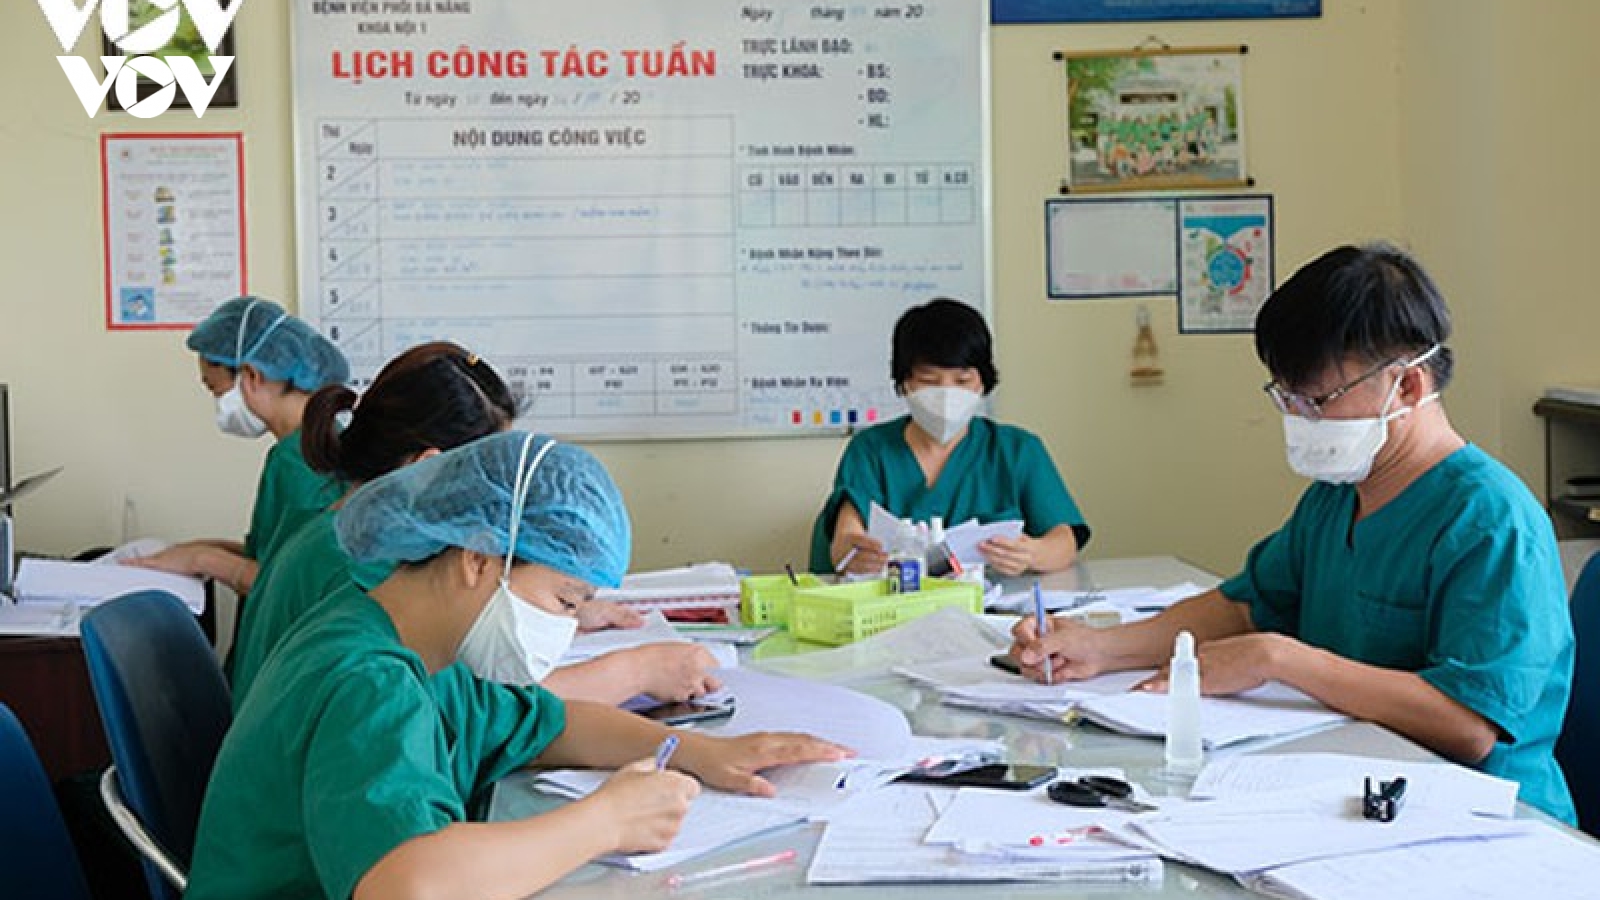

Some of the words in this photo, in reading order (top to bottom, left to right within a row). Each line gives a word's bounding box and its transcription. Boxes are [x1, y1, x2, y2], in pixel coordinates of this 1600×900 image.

[358, 22, 390, 34] KHOA
[332, 50, 414, 84] LỊCH
[427, 44, 529, 78] CÔNG
[540, 44, 609, 78] TÁC
[427, 94, 456, 108] ngày
[519, 94, 549, 108] ngày
[453, 128, 486, 149] NỘI
[492, 131, 543, 147] DUNG
[548, 128, 599, 147] CÔNG
[604, 127, 647, 148] VIỆC
[327, 165, 337, 180] 2
[328, 207, 337, 222] 3
[329, 247, 339, 262] 4
[329, 289, 339, 304] 5
